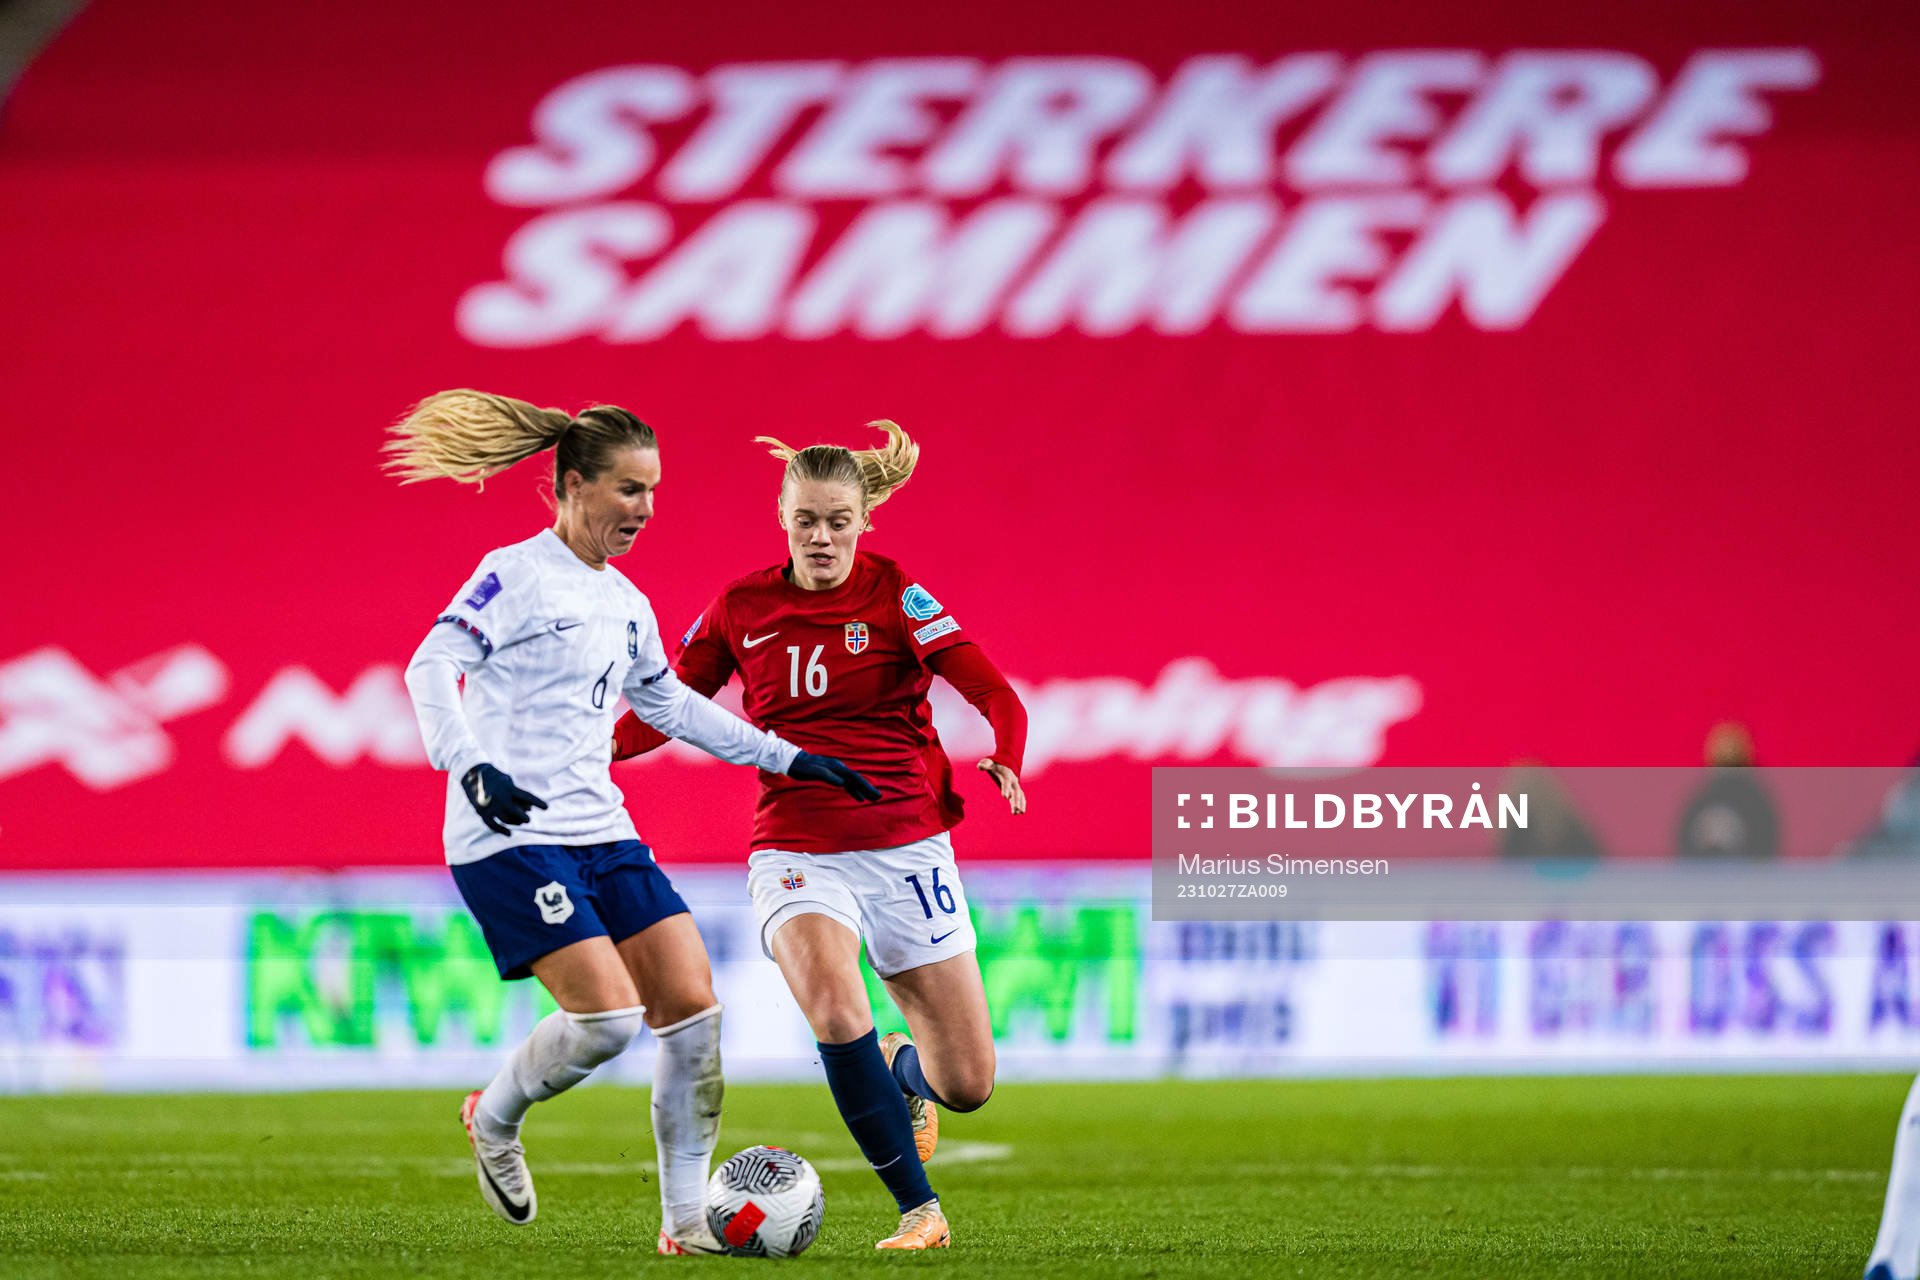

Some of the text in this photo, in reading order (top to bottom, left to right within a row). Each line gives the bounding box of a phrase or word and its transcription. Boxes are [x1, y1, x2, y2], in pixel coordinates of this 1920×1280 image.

[484, 48, 1821, 206] STERKERE
[455, 191, 1606, 347] SAMMEN
[591, 660, 615, 710] 6
[786, 645, 828, 698] 16
[904, 867, 957, 919] 16
[1690, 916, 1836, 1036] OSS
